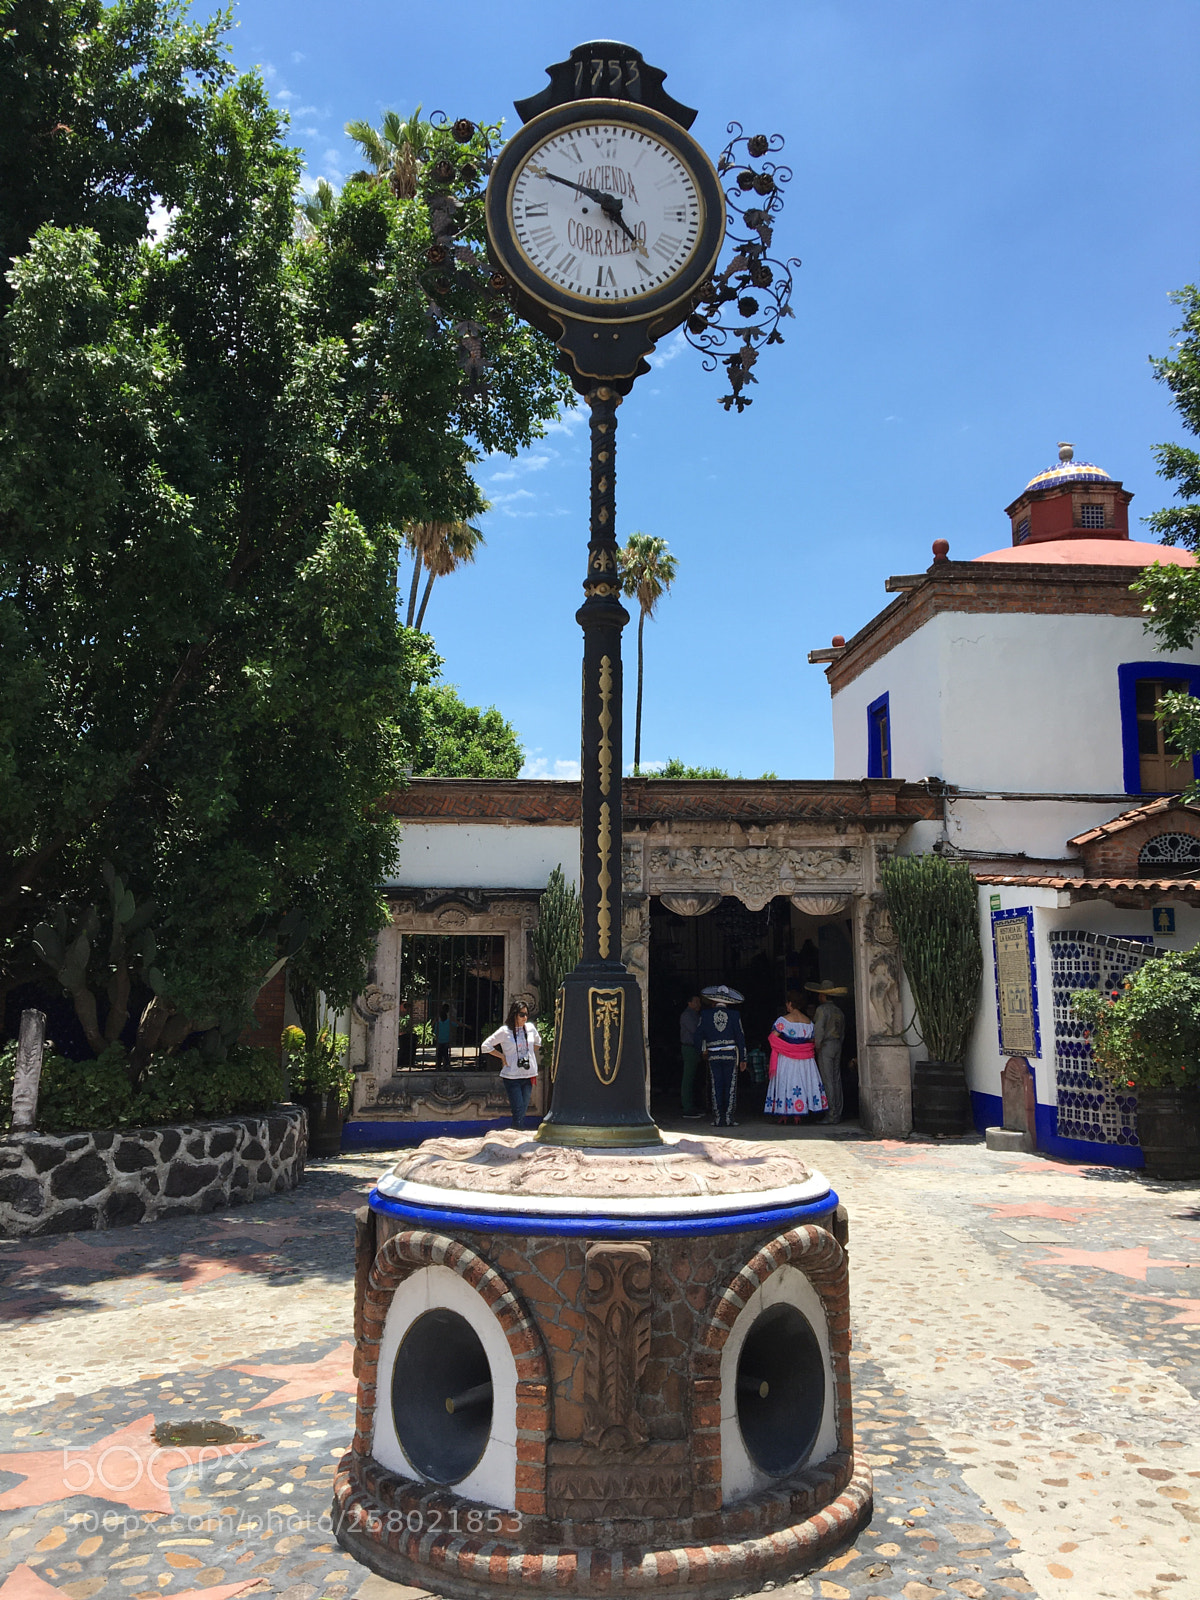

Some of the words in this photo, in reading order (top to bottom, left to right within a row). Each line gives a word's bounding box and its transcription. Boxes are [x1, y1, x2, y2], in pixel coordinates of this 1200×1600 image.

[574, 59, 640, 86] 1753
[574, 165, 640, 206] HACIENDA
[567, 217, 647, 257] CORRALEJO
